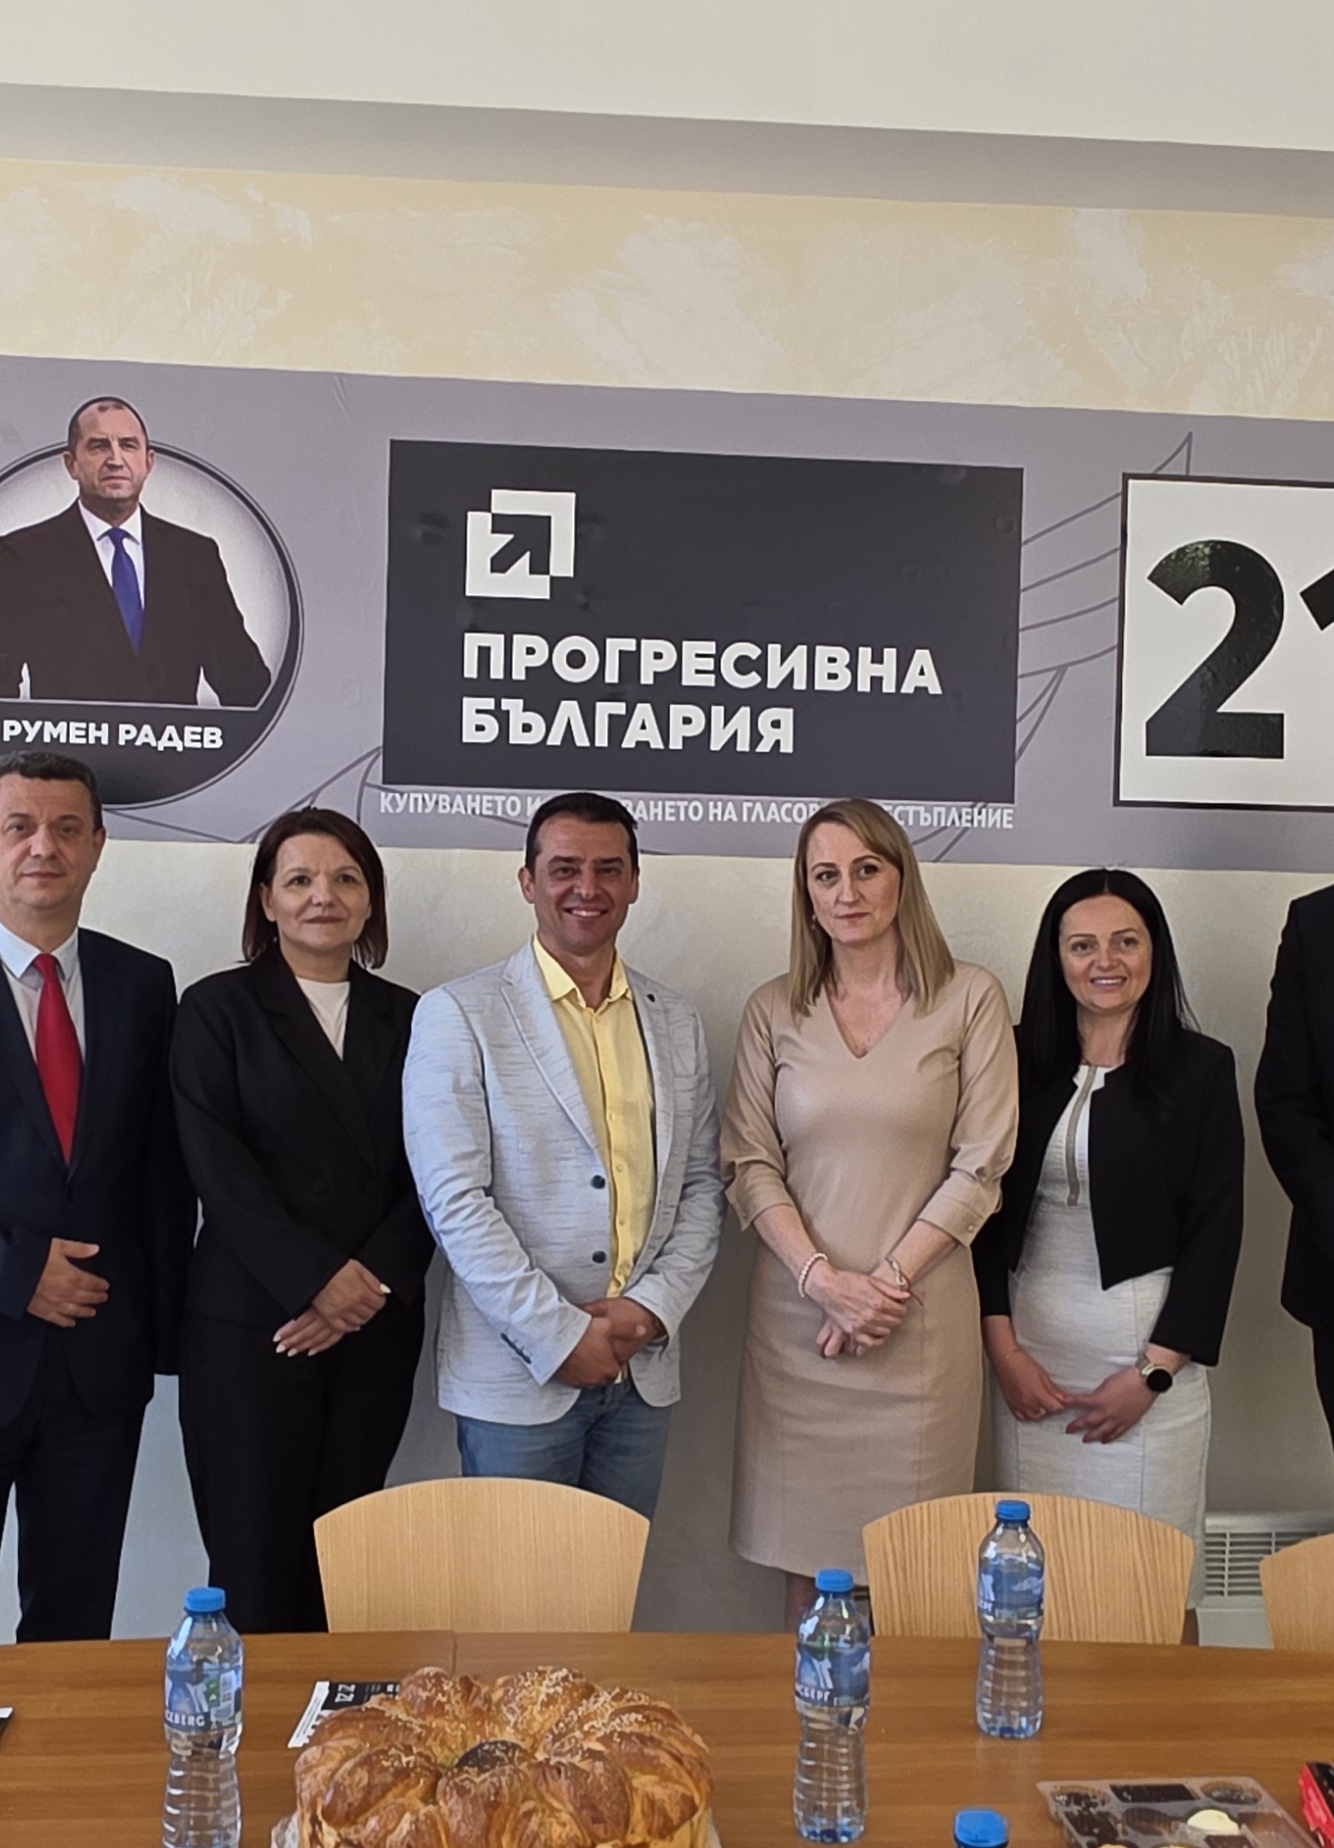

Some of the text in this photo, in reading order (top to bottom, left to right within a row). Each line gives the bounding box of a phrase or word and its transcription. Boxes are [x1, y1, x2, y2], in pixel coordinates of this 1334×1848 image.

[463, 632, 943, 695] ПРОГРЕСИВНА
[2, 719, 223, 752] РУМЕН РАДЕВ
[462, 697, 794, 753] БЪЛГАРИЯ
[379, 792, 521, 817] КУПУВАНЕТО
[708, 800, 739, 822] НА
